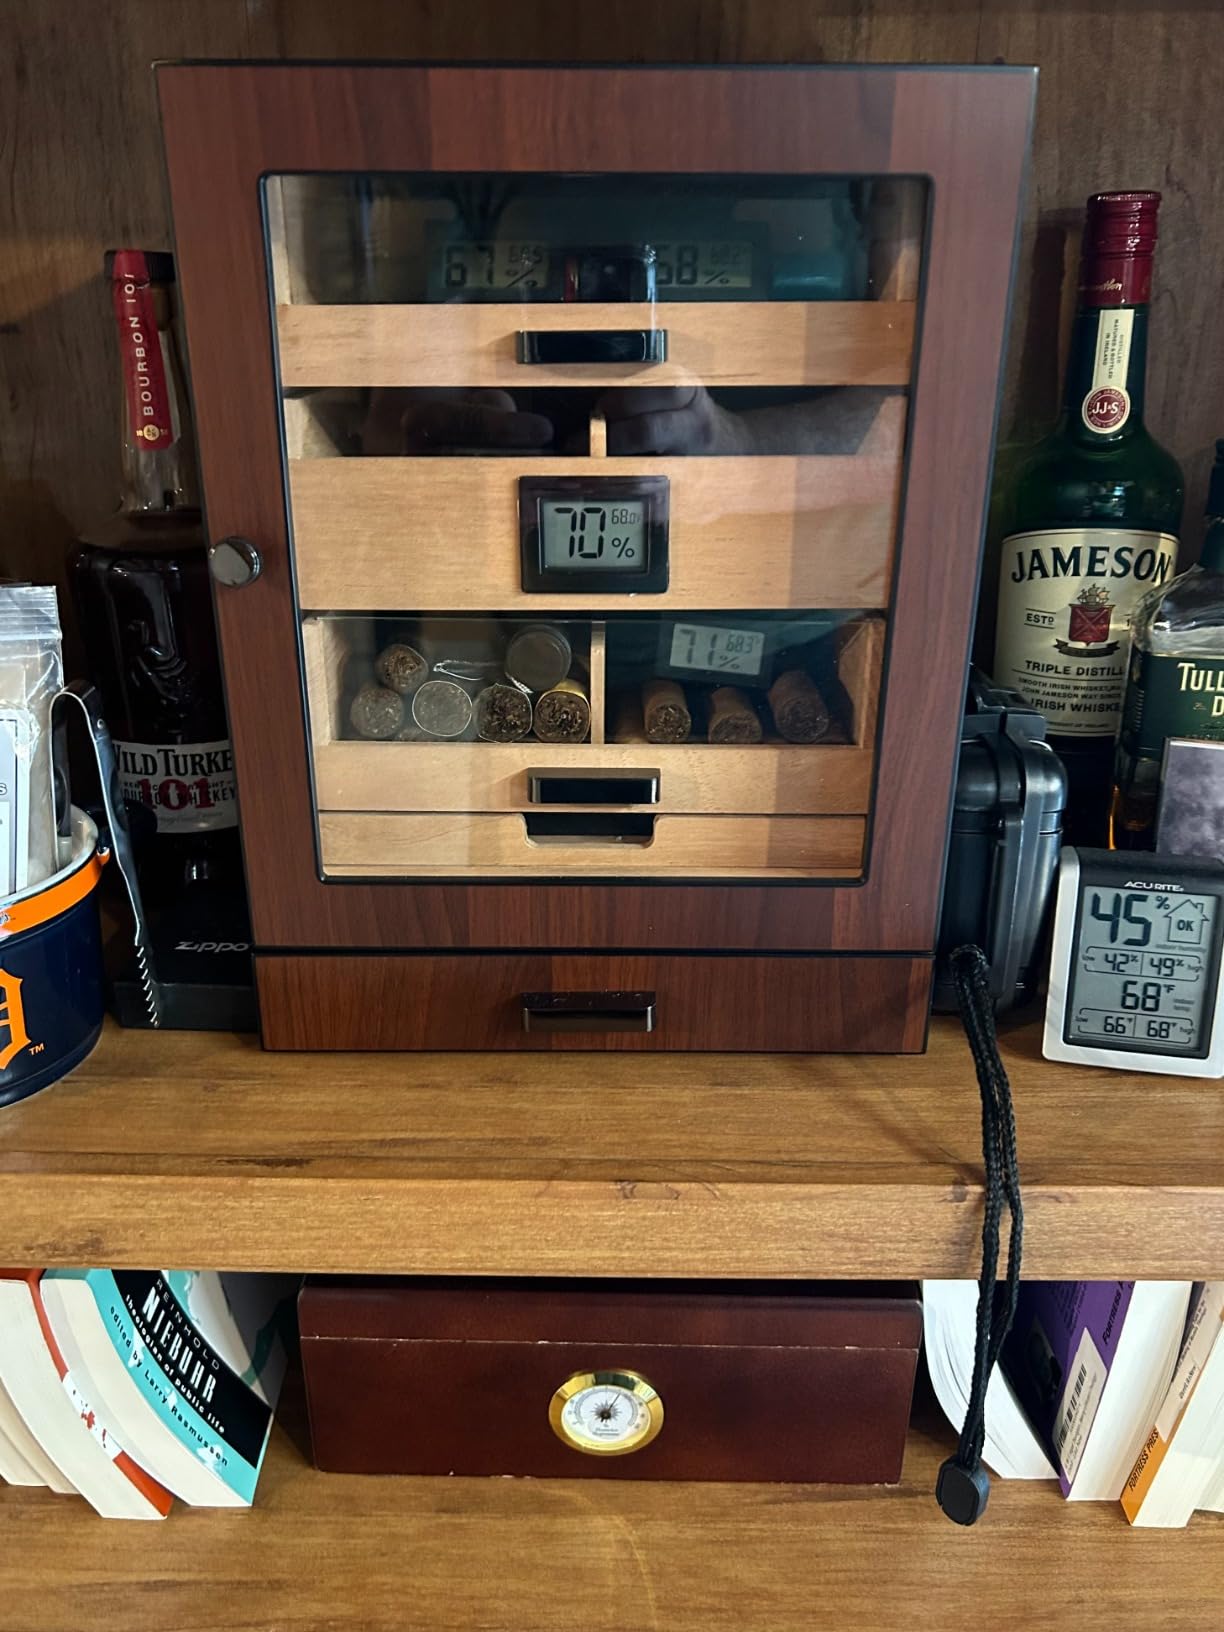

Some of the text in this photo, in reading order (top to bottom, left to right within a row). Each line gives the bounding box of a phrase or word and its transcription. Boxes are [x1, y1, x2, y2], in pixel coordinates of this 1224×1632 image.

[128, 316, 154, 416] BOURBON
[554, 507, 606, 559] 70
[1011, 546, 1171, 583] JAMESON
[680, 629, 718, 666] 71
[1025, 660, 1072, 675] TRIPLE
[1177, 662, 1224, 692] TULL
[1042, 690, 1079, 699] JAMESON
[1049, 682, 1071, 691] IRISH
[1030, 697, 1067, 713] IRISH
[1211, 695, 1224, 717] D
[157, 749, 233, 776] TURKE
[138, 777, 215, 811] 101
[1177, 920, 1194, 931] OK
[29, 1043, 45, 1056] TM
[156, 1279, 220, 1370] REINHOLD
[142, 1286, 217, 1403] NIEBUHR
[126, 1294, 225, 1434] theologian of public life
[110, 1305, 228, 1467] edited by Larry Rasmussen
[1128, 1427, 1159, 1492] FORTRESS PRES
